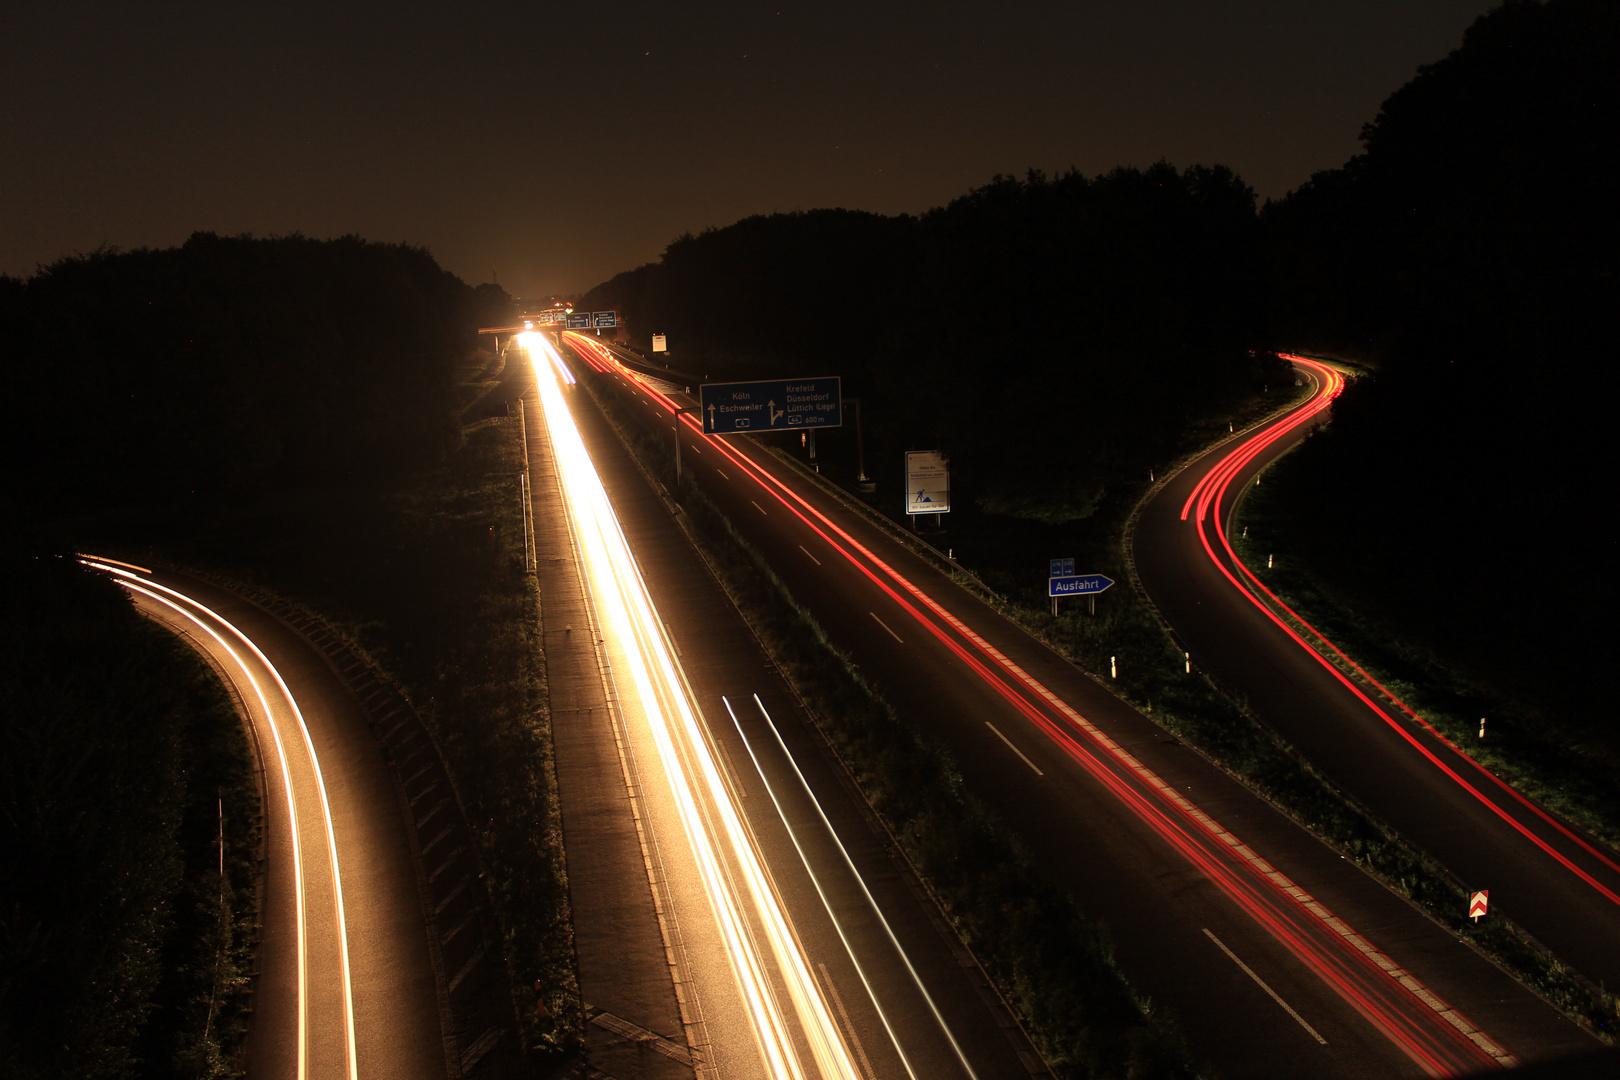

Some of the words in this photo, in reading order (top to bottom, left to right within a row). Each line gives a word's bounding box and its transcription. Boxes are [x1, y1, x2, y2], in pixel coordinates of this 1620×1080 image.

[786, 384, 815, 393] Krefeld
[732, 392, 751, 400] Köln
[786, 393, 829, 403] Düsseldorf
[719, 403, 763, 413] Eschweiler
[787, 402, 814, 412] Lüttich
[1055, 579, 1100, 592] Ausfahrt
